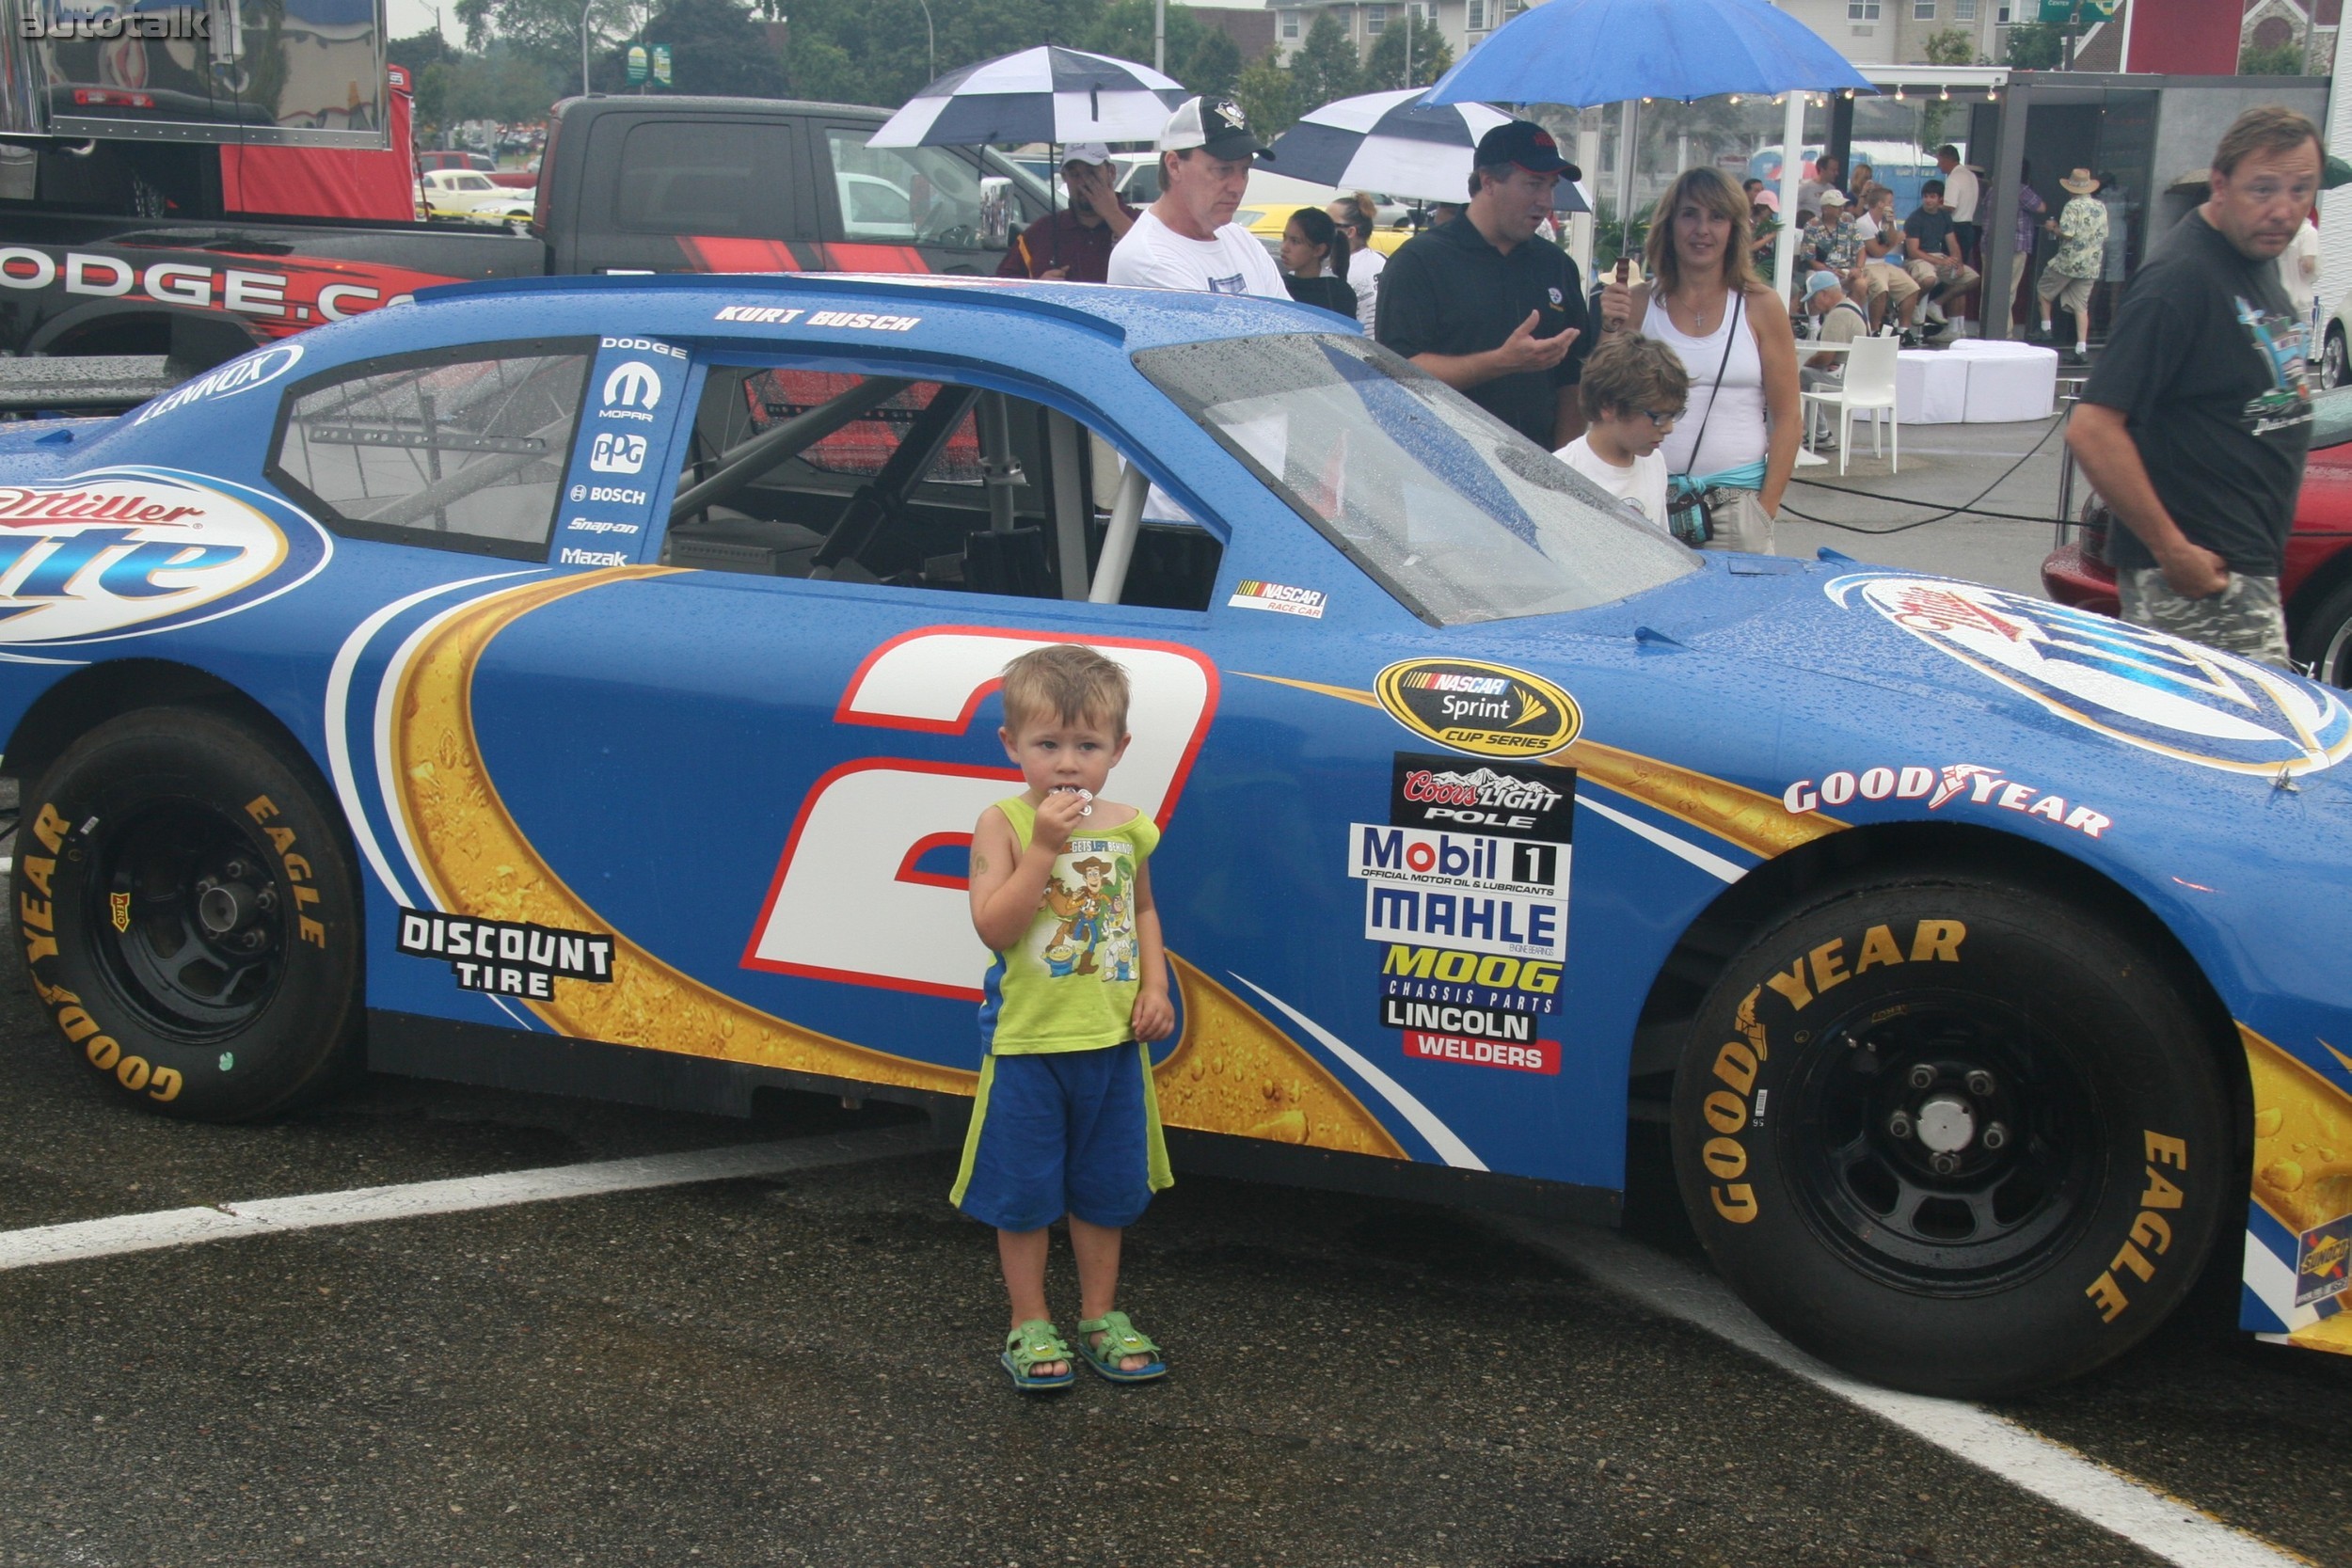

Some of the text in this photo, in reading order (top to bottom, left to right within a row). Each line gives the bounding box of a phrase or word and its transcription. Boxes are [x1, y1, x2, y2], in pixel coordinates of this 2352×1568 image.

[715, 306, 921, 331] KURT BUSCH
[601, 337, 688, 360] DODGE
[134, 352, 275, 427] LENNOX
[598, 409, 655, 423] MOPAR
[589, 486, 646, 505] BOSCH
[567, 517, 639, 534] Snap-on
[560, 547, 628, 567] Mazak
[1261, 583, 1322, 606] NASCAR
[1267, 601, 1321, 617] RACE CAR
[1433, 673, 1505, 695] NASCAR
[1441, 695, 1511, 721] Sprint
[1445, 730, 1551, 749] CUP SERIES
[1404, 769, 1564, 813] Coors LIGHT
[739, 625, 1221, 1005] 2
[1423, 807, 1537, 830] POLE
[1072, 840, 1091, 853] GETS
[1362, 827, 1541, 883] Mobil 1
[245, 794, 326, 950] EAGLE
[1360, 868, 1555, 897] OFFICIAL MOTOR OIL & LUBRICANTS
[1372, 887, 1557, 948] MAHLE
[403, 914, 609, 975] DISCOUNT
[457, 961, 549, 997] TIRE
[1382, 944, 1564, 994] MOOG
[1390, 979, 1552, 1014] CHASSIS PARTS
[1388, 1000, 1530, 1041] LINCOLN
[1418, 1035, 1543, 1069] WELDERS
[2085, 1129, 2187, 1323] EAGLE
